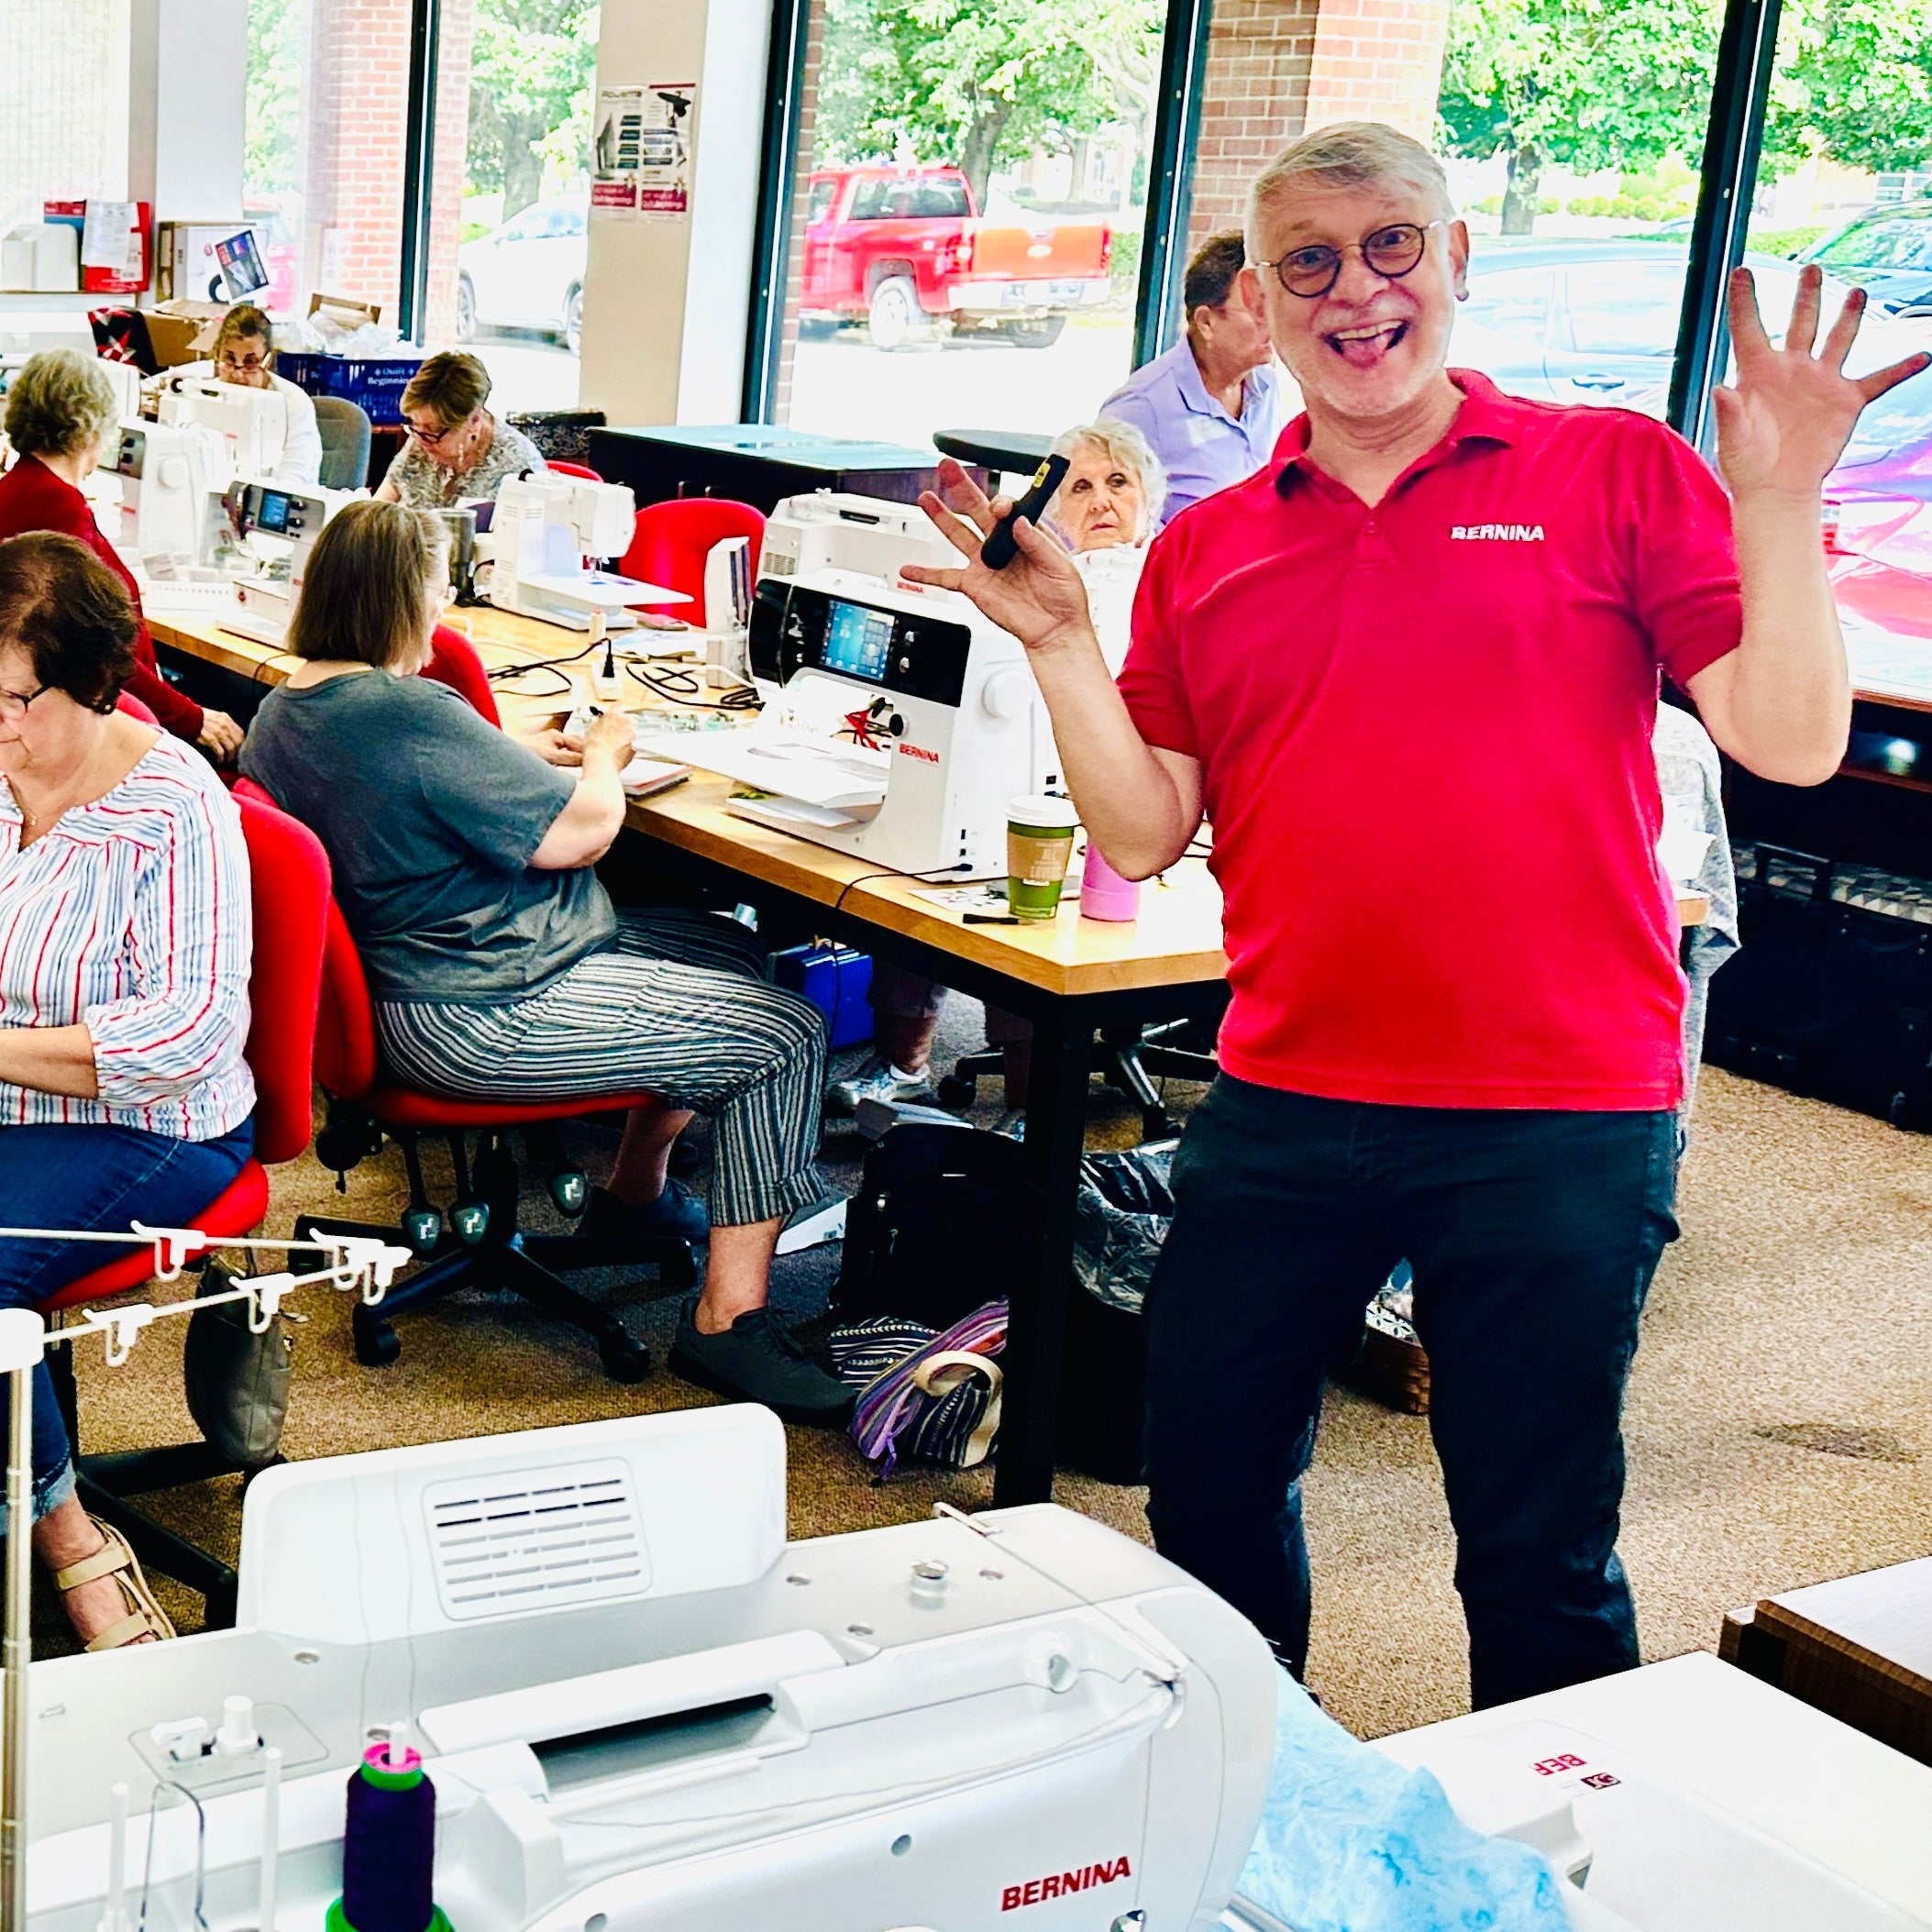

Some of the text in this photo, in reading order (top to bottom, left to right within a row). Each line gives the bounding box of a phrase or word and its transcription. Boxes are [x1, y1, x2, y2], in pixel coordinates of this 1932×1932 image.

[1451, 524, 1544, 541] BERNINA
[900, 744, 939, 763] BERNINA
[1001, 1856, 1131, 1911] BERNINA
